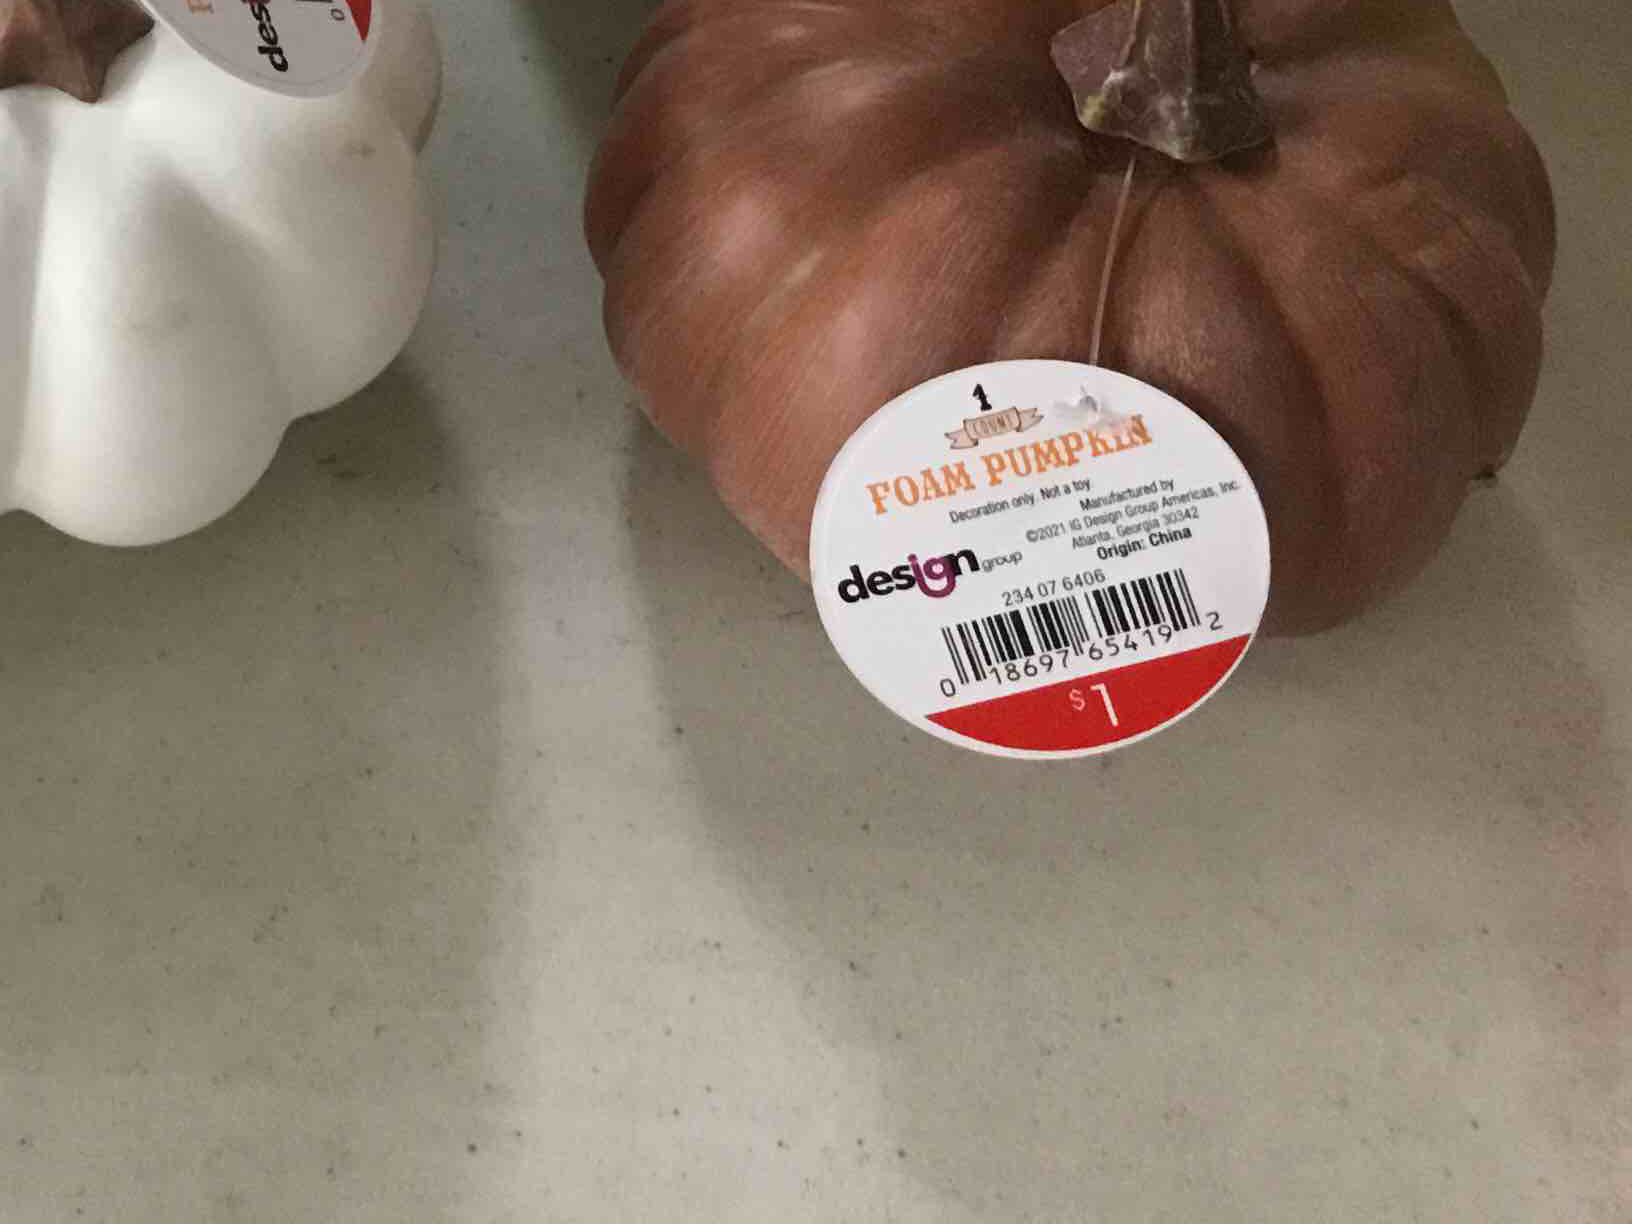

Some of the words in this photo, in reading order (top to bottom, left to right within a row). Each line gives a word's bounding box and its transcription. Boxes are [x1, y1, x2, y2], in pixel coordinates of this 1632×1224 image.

[972, 383, 992, 411] 1
[865, 460, 976, 515] FOAM
[980, 413, 1152, 487] PUMPKIN
[948, 499, 1010, 523] Decoration
[1039, 484, 1061, 500] Not
[1062, 483, 1071, 494] a
[1071, 478, 1090, 491] toy
[1078, 480, 1158, 511] Manufactured
[1158, 478, 1174, 492] by
[1082, 509, 1123, 528] Design
[1123, 500, 1159, 518] Group
[1115, 517, 1160, 538] Georgia
[1095, 539, 1142, 560] Origin:
[1147, 526, 1192, 547] China
[837, 548, 980, 603] design
[980, 551, 1023, 573] group
[1001, 585, 1034, 607] 234
[1036, 579, 1056, 598] 07
[1061, 568, 1106, 591] 6406
[939, 677, 956, 698] 0
[988, 648, 1069, 685] 18697
[1087, 623, 1172, 661] 65419
[1205, 610, 1223, 631] 2
